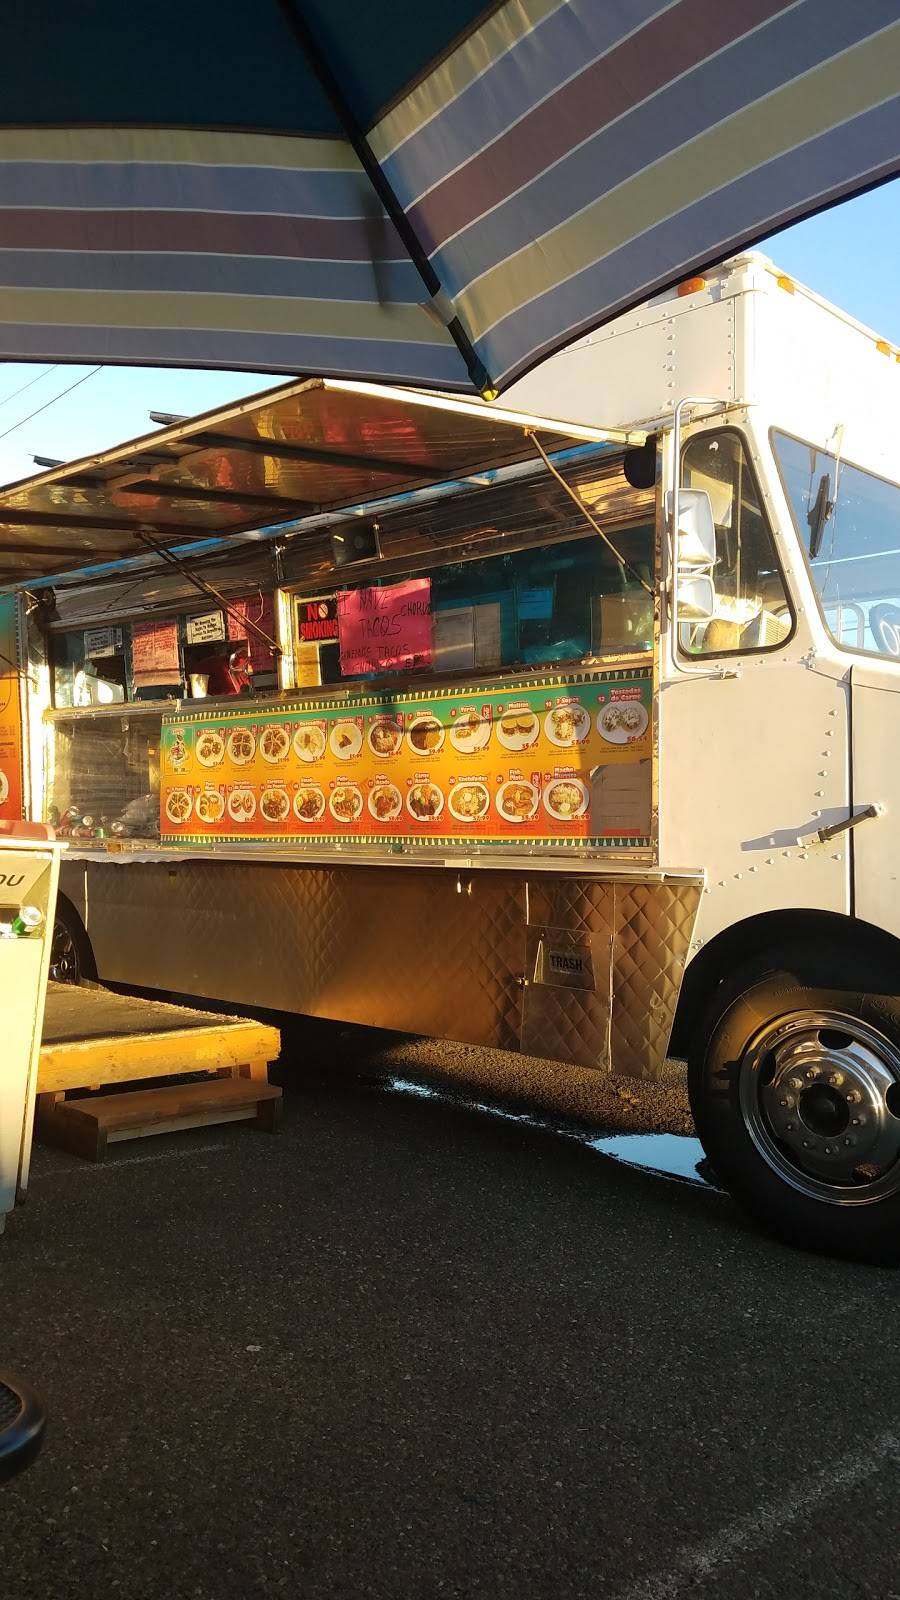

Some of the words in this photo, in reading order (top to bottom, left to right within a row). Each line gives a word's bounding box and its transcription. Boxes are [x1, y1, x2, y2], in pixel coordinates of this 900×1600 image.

[300, 620, 338, 641] SMOKING
[359, 613, 402, 639] TACOS
[550, 955, 583, 971] TRASH
